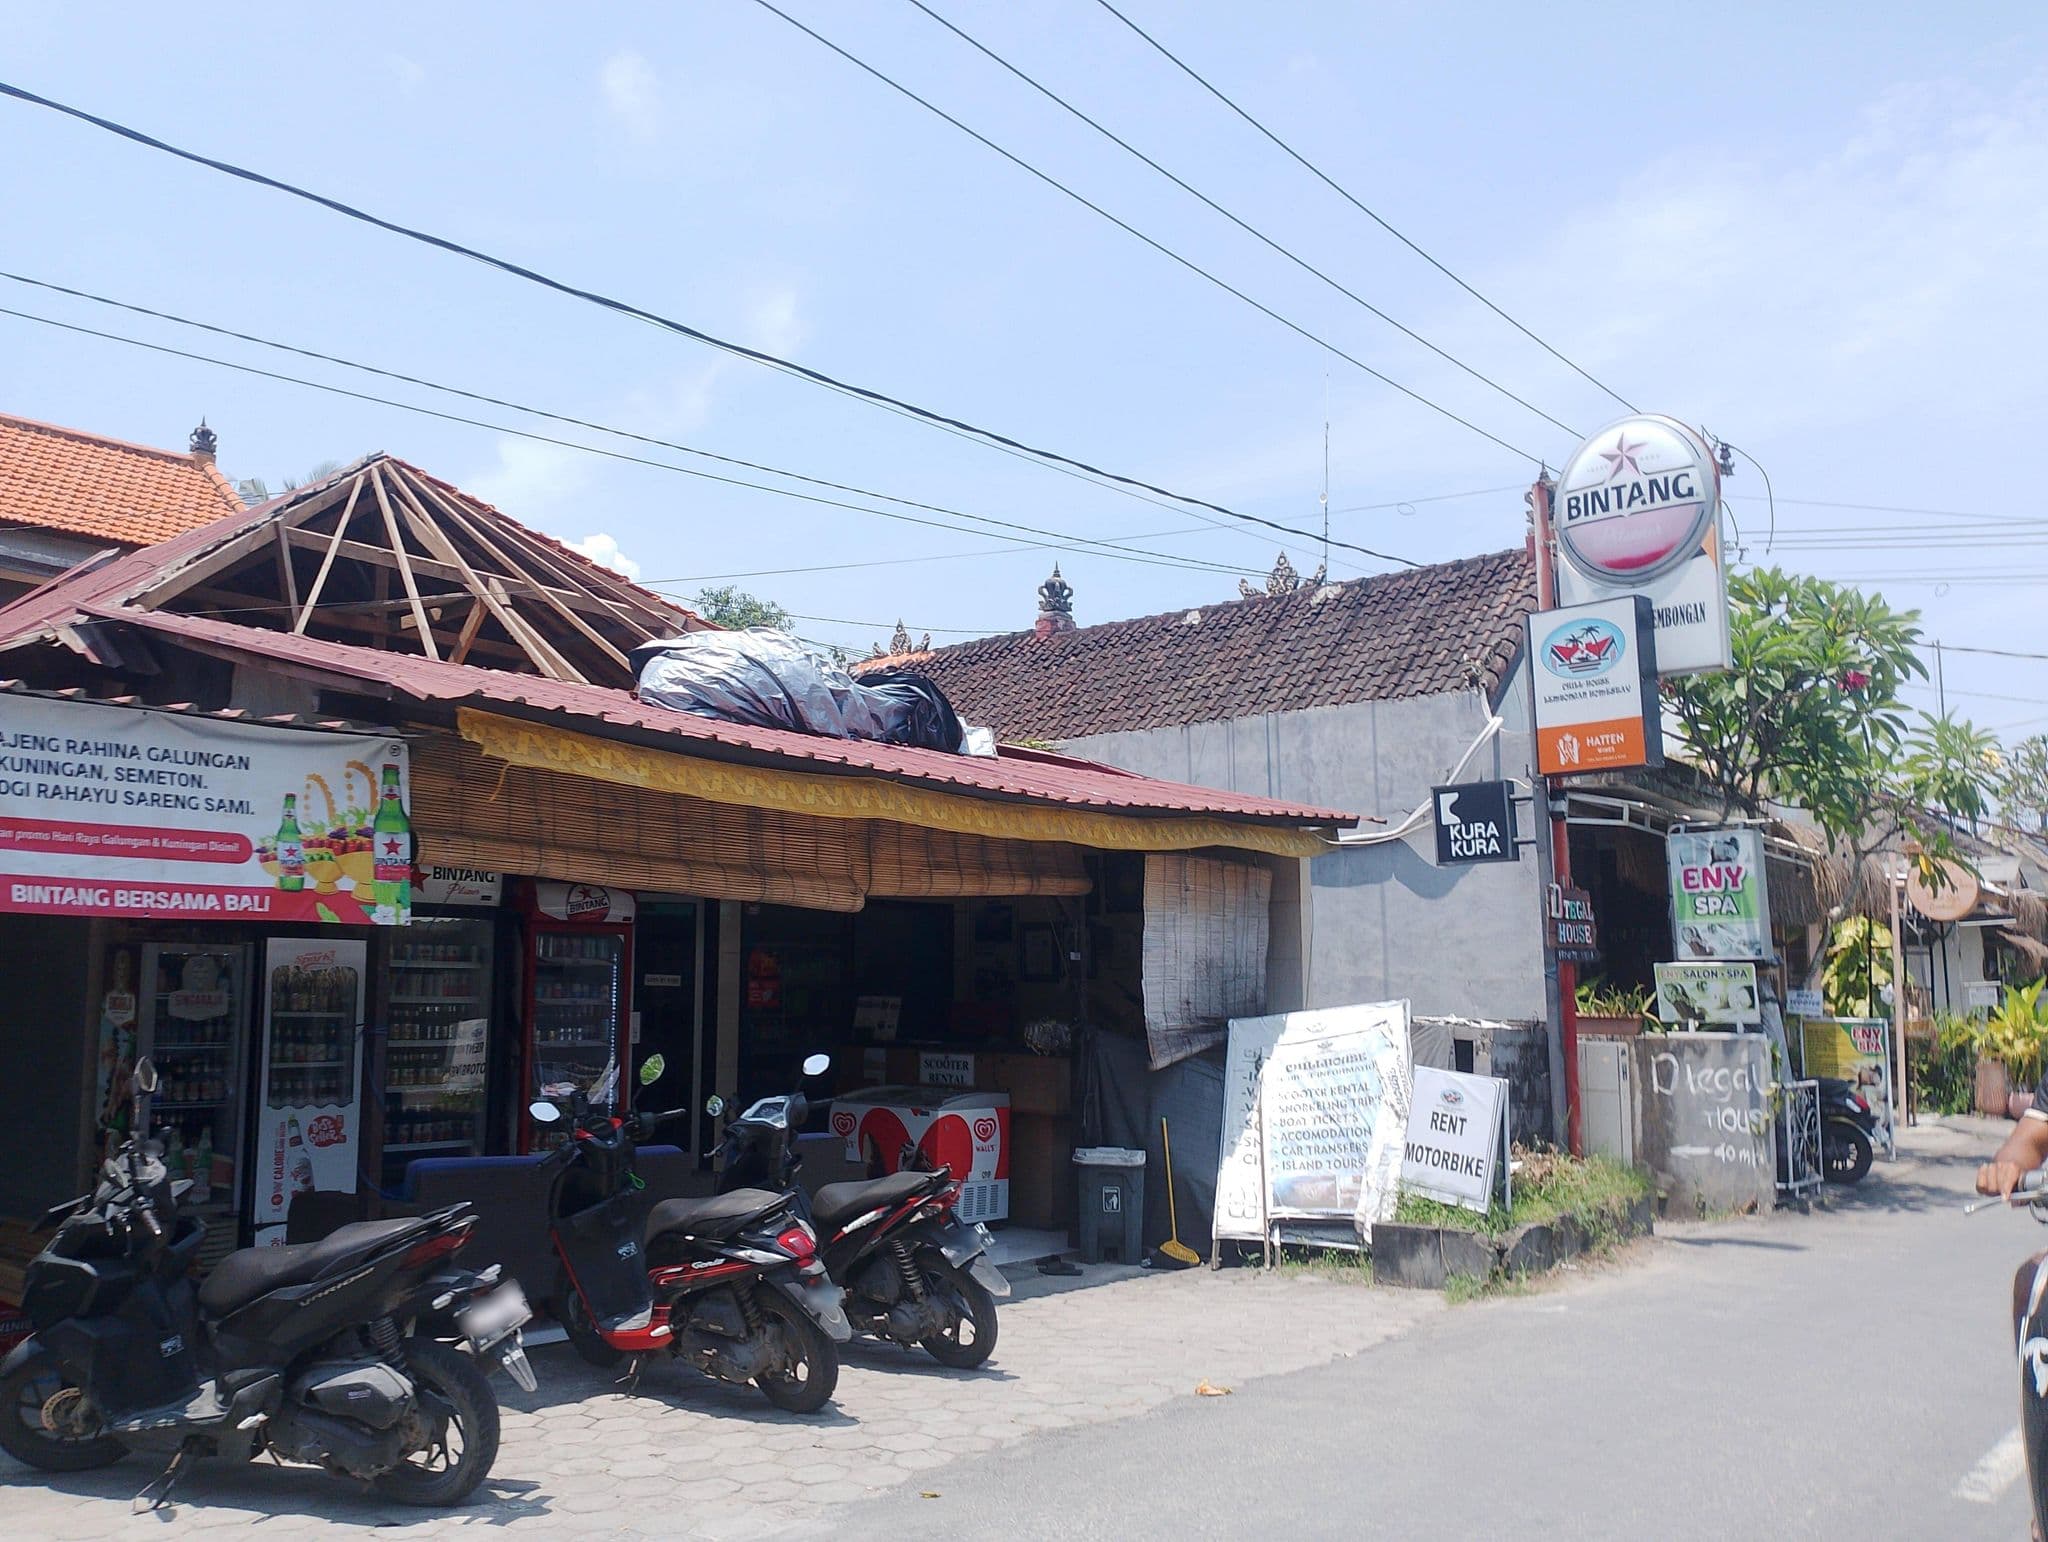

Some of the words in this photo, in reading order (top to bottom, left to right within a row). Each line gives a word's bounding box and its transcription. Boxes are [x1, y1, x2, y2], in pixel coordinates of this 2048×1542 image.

[1567, 473, 1695, 521] BINTANG
[1586, 732, 1625, 748] HATTEN
[65, 739, 141, 761] RAHINA
[147, 747, 250, 771] GALUNGAN
[114, 766, 209, 790] SEMETON.
[37, 783, 118, 805] RAHAYU
[122, 791, 200, 811] SARENG
[205, 798, 255, 815] SAMI.
[1449, 821, 1500, 840] KURA
[76, 833, 101, 846] Raya
[102, 834, 151, 848] Galungan
[162, 839, 208, 852] Kuningan
[1450, 838, 1501, 857] KURA
[432, 866, 496, 883] BINTANG
[1682, 864, 1743, 890] ENY
[11, 884, 110, 906] BINTANG
[114, 889, 221, 911] BERSAMA
[224, 894, 270, 912] BALI
[570, 897, 608, 913] BINTANG
[1694, 894, 1740, 916] SPA
[1558, 922, 1593, 945] HOUSE
[1683, 968, 1719, 979] SALON
[1727, 969, 1748, 979] SPA
[1852, 1026, 1881, 1040] ENY
[1859, 1040, 1882, 1053] SPA
[923, 1059, 969, 1072] SCOOTER
[1330, 1082, 1370, 1097] RENTAL
[1430, 1111, 1468, 1136] RENT
[1281, 1125, 1372, 1143] ACCOMODATION
[1281, 1144, 1303, 1156] CAR
[1306, 1141, 1368, 1156] TRANSFERS
[1282, 1159, 1323, 1171] ISLAND
[1404, 1142, 1485, 1178] MOTORBIKE
